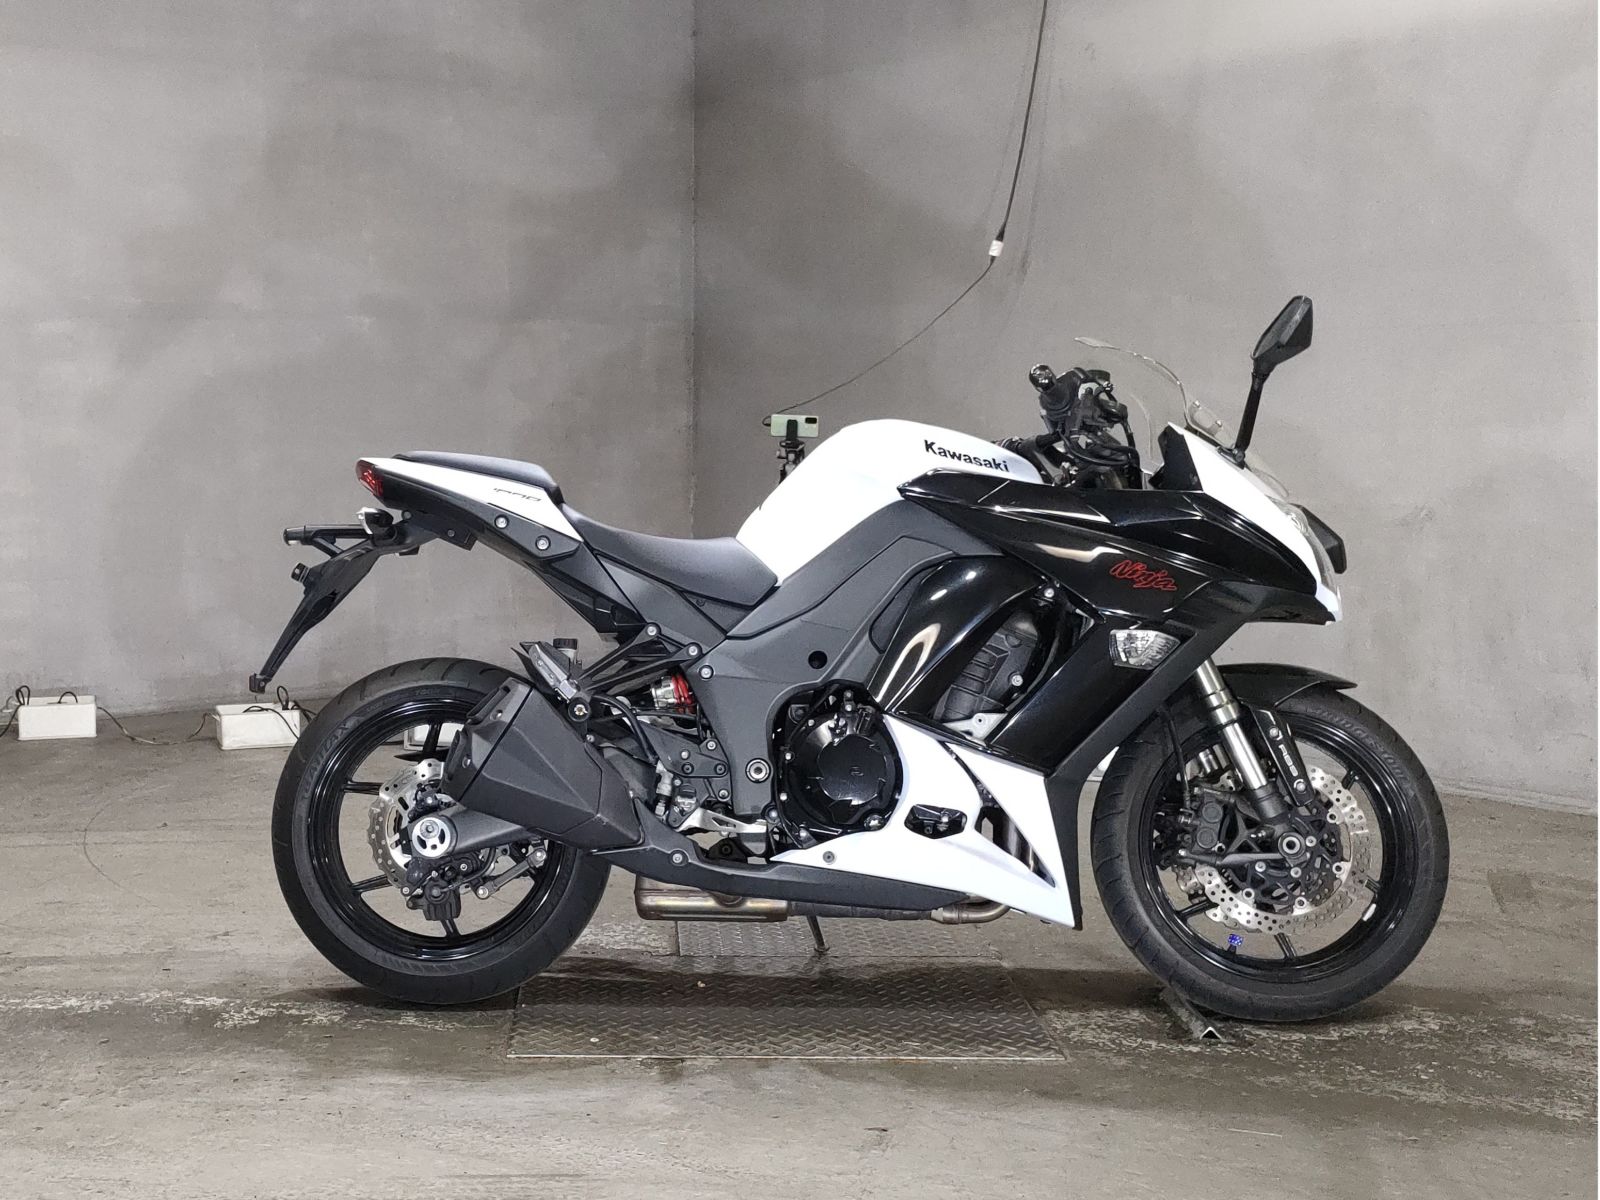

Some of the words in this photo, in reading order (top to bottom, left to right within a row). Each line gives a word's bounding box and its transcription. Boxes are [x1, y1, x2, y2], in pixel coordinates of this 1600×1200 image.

[924, 439, 1009, 472] Kawasaki
[1109, 559, 1178, 591] Ninja
[1278, 744, 1298, 777] ABS
